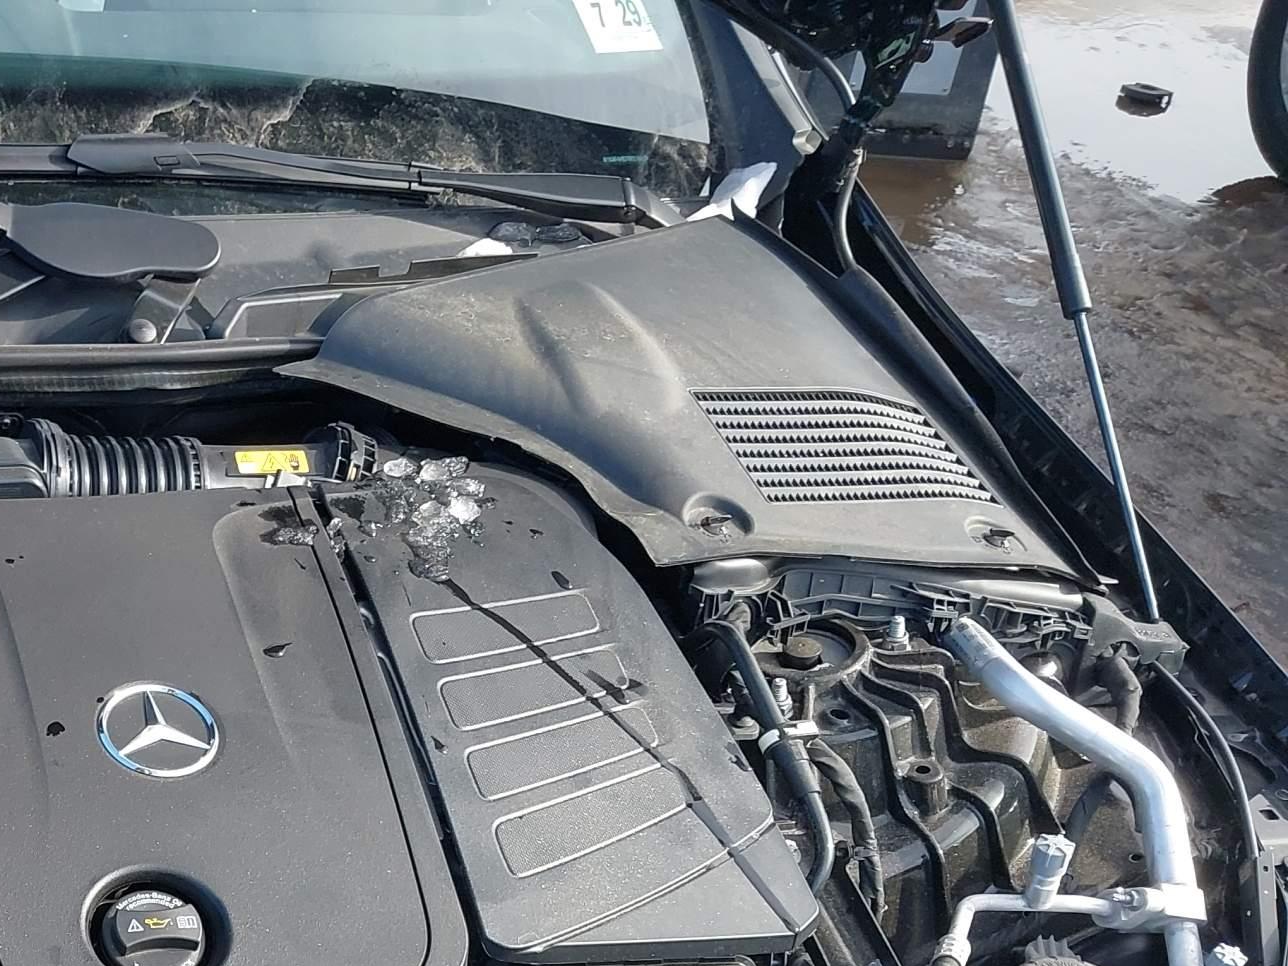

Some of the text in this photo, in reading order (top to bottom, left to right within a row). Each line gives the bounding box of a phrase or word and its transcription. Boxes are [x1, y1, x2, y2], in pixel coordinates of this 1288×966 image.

[590, 0, 642, 28] 7 29
[116, 892, 172, 910] Mercedes-Benz
[126, 898, 174, 911] recommended
